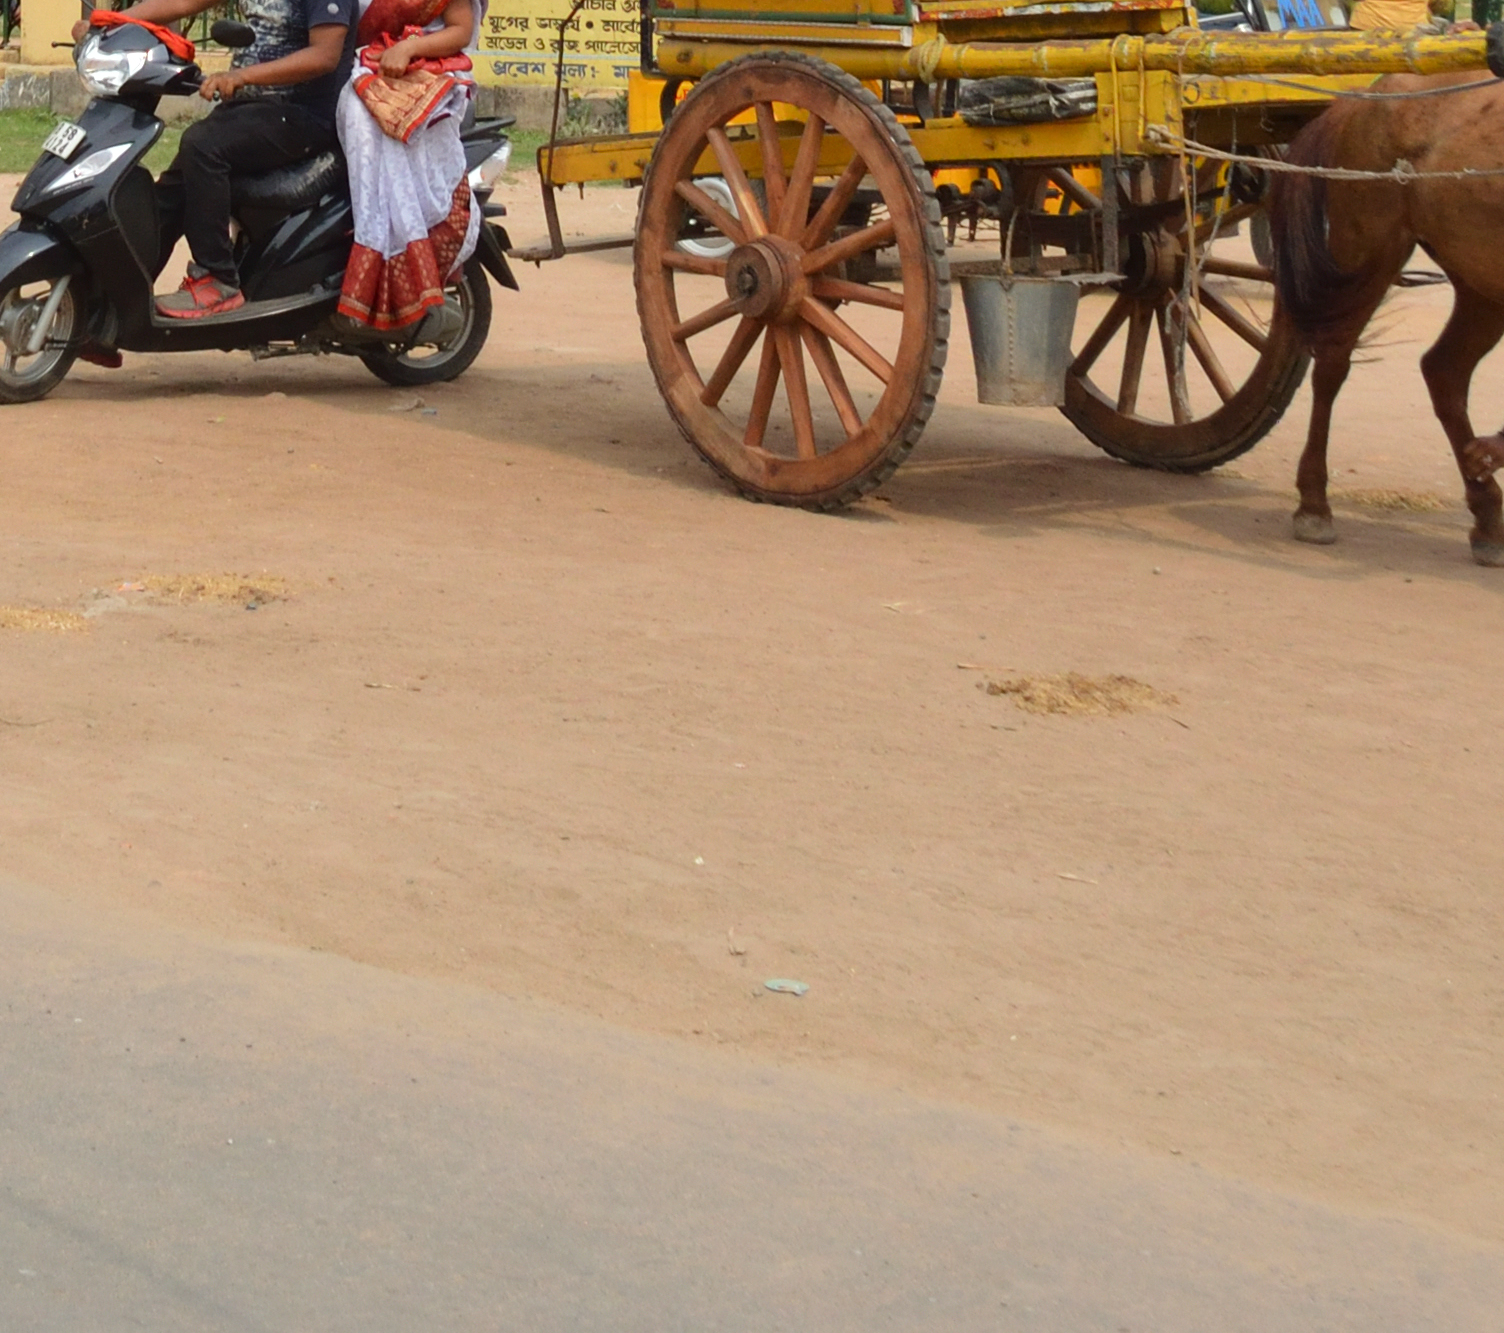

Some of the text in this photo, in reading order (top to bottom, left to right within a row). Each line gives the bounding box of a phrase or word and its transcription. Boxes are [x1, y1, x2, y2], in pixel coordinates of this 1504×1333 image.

[488, 15, 530, 34] যুগের
[485, 35, 527, 51] মডেল
[534, 37, 545, 51] ও
[491, 60, 546, 79] প্রবেশ
[62, 125, 78, 141] 58
